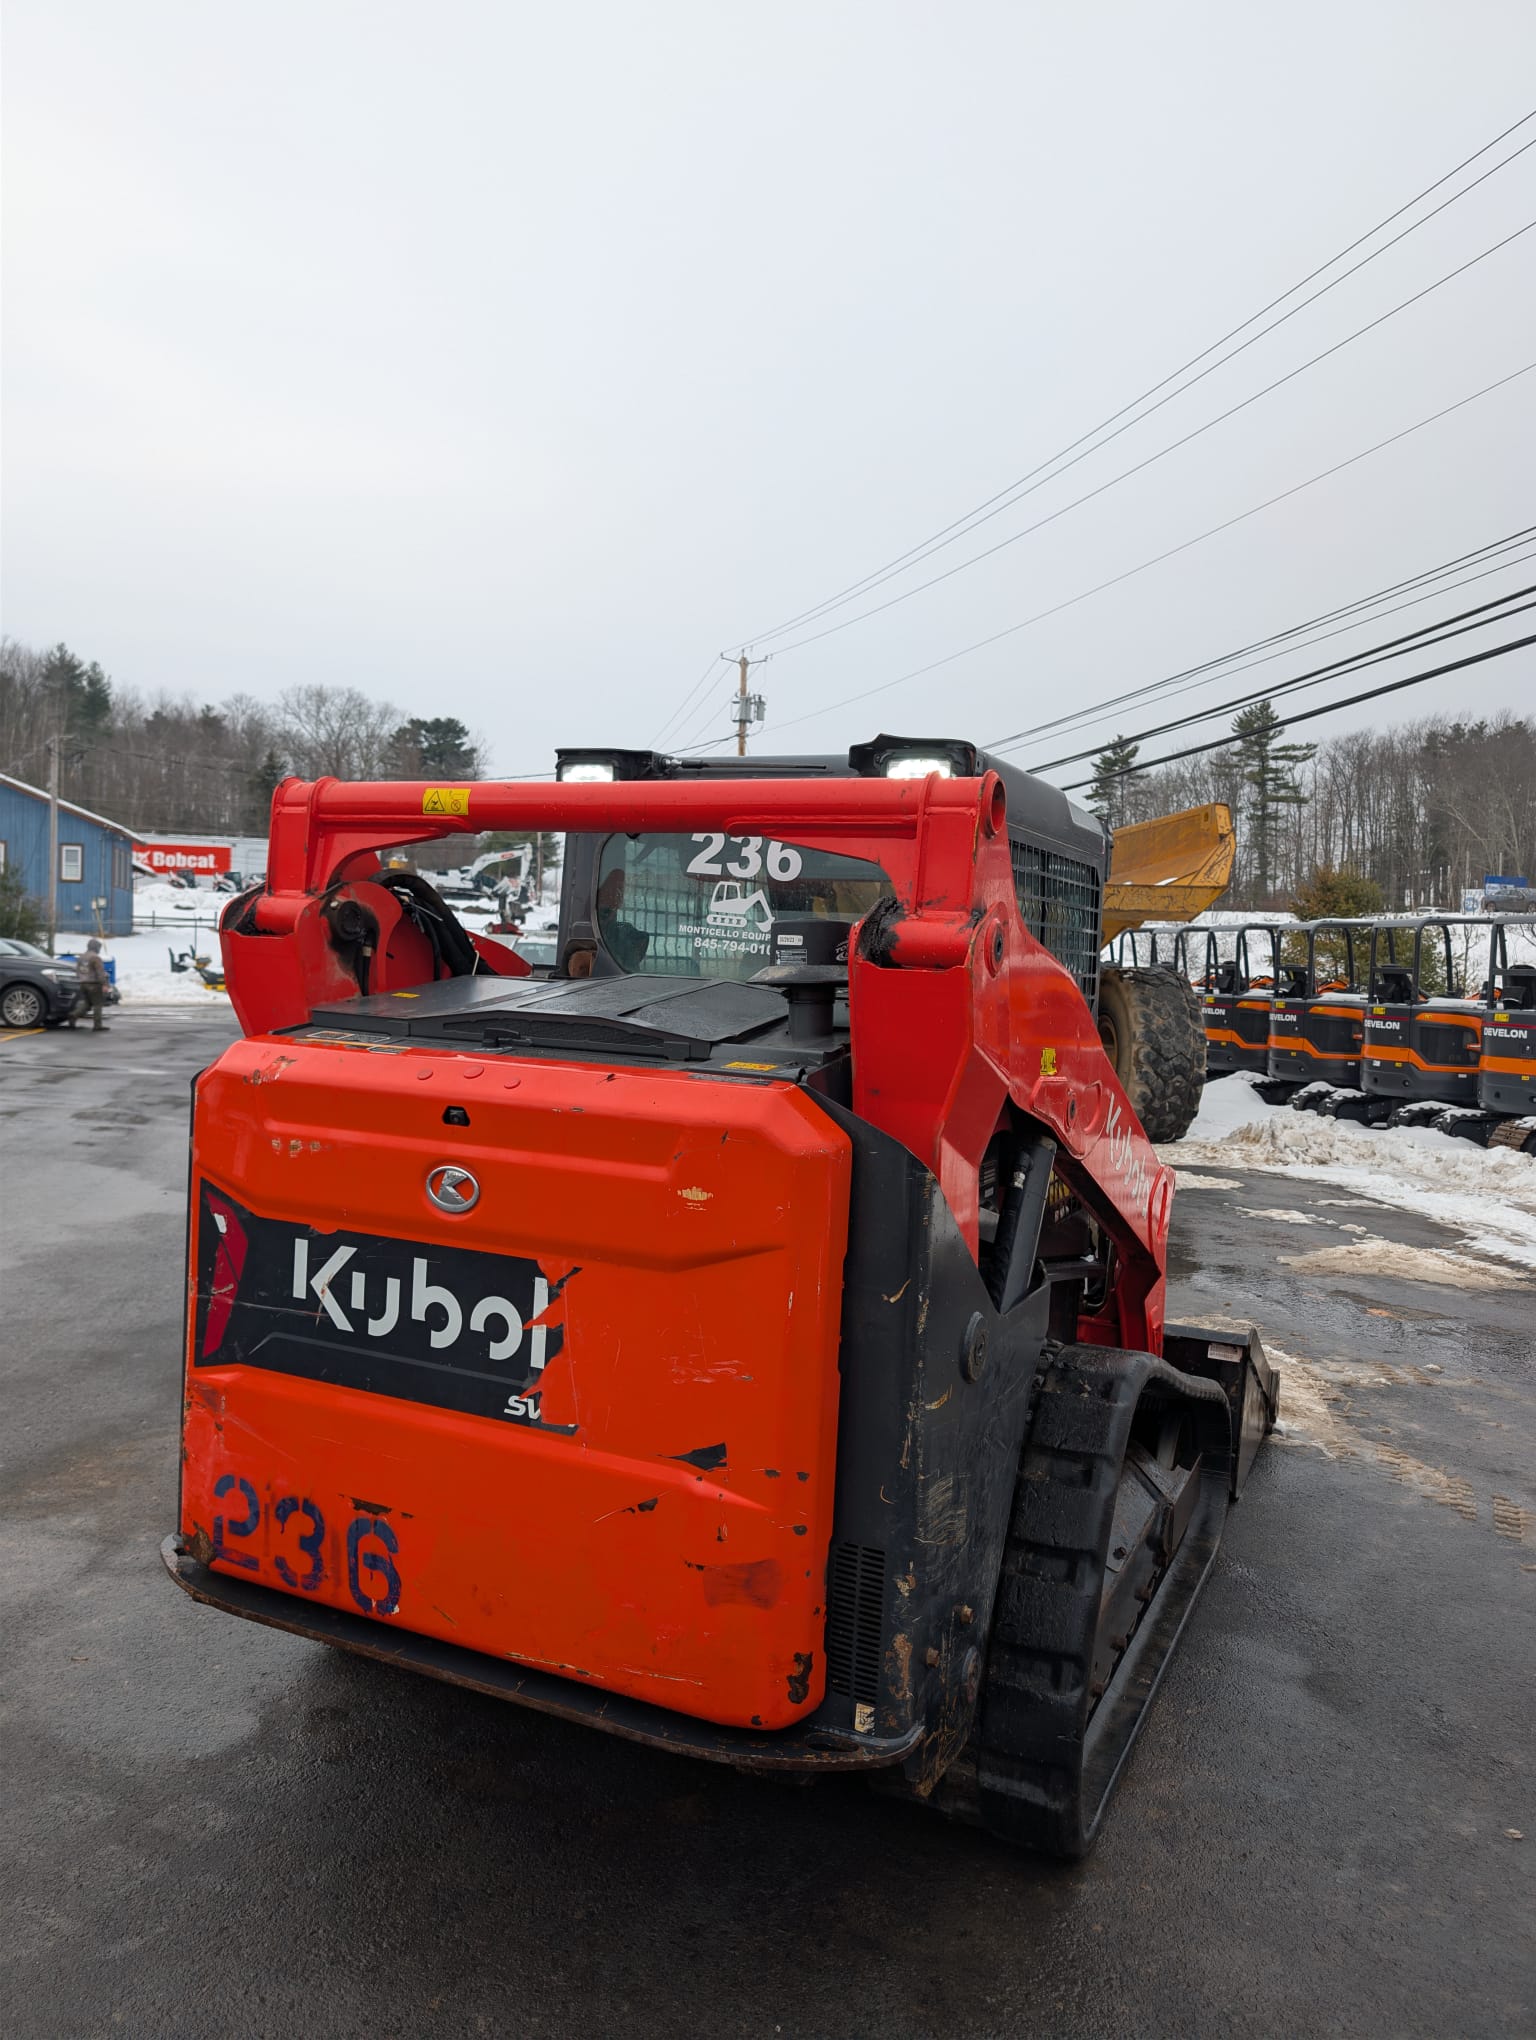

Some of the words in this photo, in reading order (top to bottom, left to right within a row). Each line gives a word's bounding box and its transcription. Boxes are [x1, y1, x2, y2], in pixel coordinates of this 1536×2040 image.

[152, 851, 216, 869] Bobcat
[686, 833, 802, 881] 236
[679, 924, 739, 938] MONTICELLO
[1483, 1026, 1528, 1039] DEVELON
[213, 1474, 402, 1616] 236
